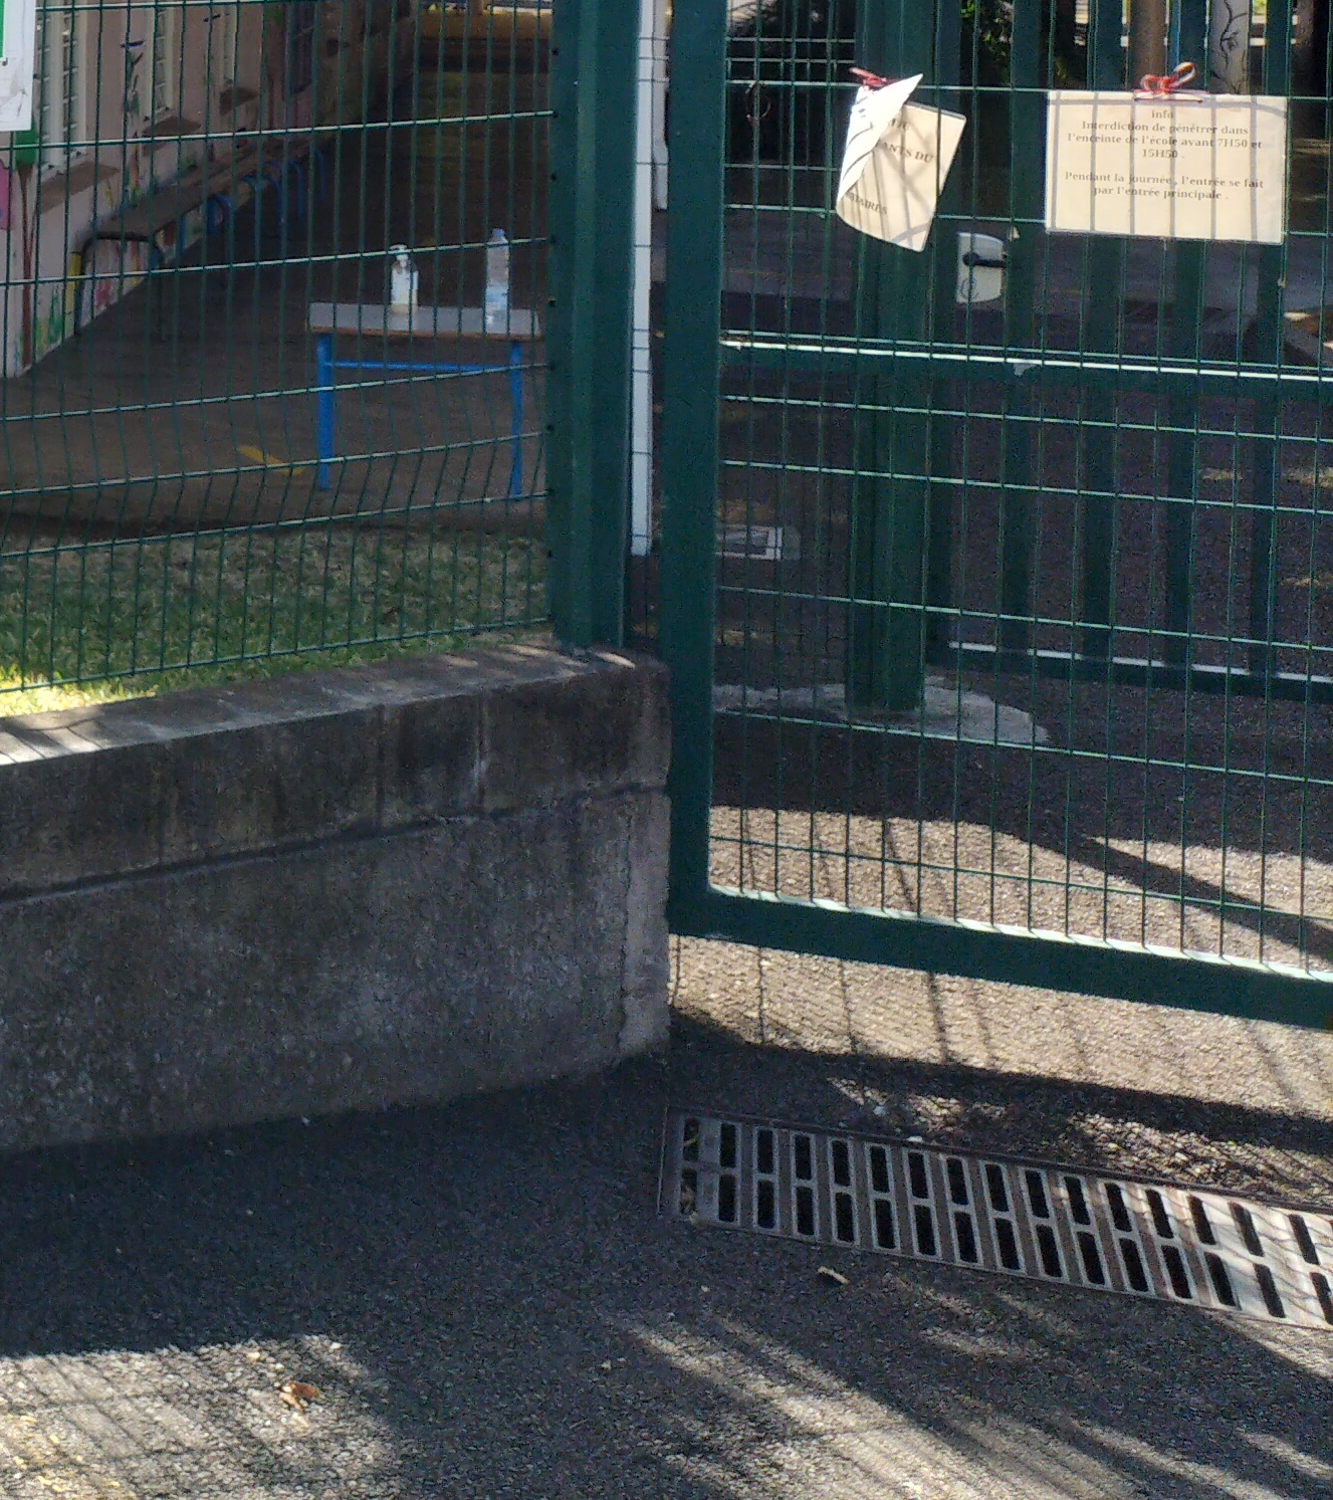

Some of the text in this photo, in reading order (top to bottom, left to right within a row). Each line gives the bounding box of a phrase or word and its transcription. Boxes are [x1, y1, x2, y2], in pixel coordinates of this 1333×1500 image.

[1151, 110, 1174, 119] info
[1082, 121, 1149, 132] Interdiction
[1152, 122, 1165, 132] de
[1221, 125, 1249, 135] dans
[1126, 135, 1138, 144] de
[1181, 138, 1214, 147] avant
[1218, 139, 1248, 148] 7H50
[1251, 140, 1262, 149] et
[1142, 149, 1178, 158] 15H50
[1065, 172, 1111, 182] Pendant
[1114, 173, 1124, 182] la
[1229, 179, 1240, 187] se
[1244, 179, 1264, 188] fait
[1094, 188, 1114, 197] par
[1163, 189, 1222, 200] principale
